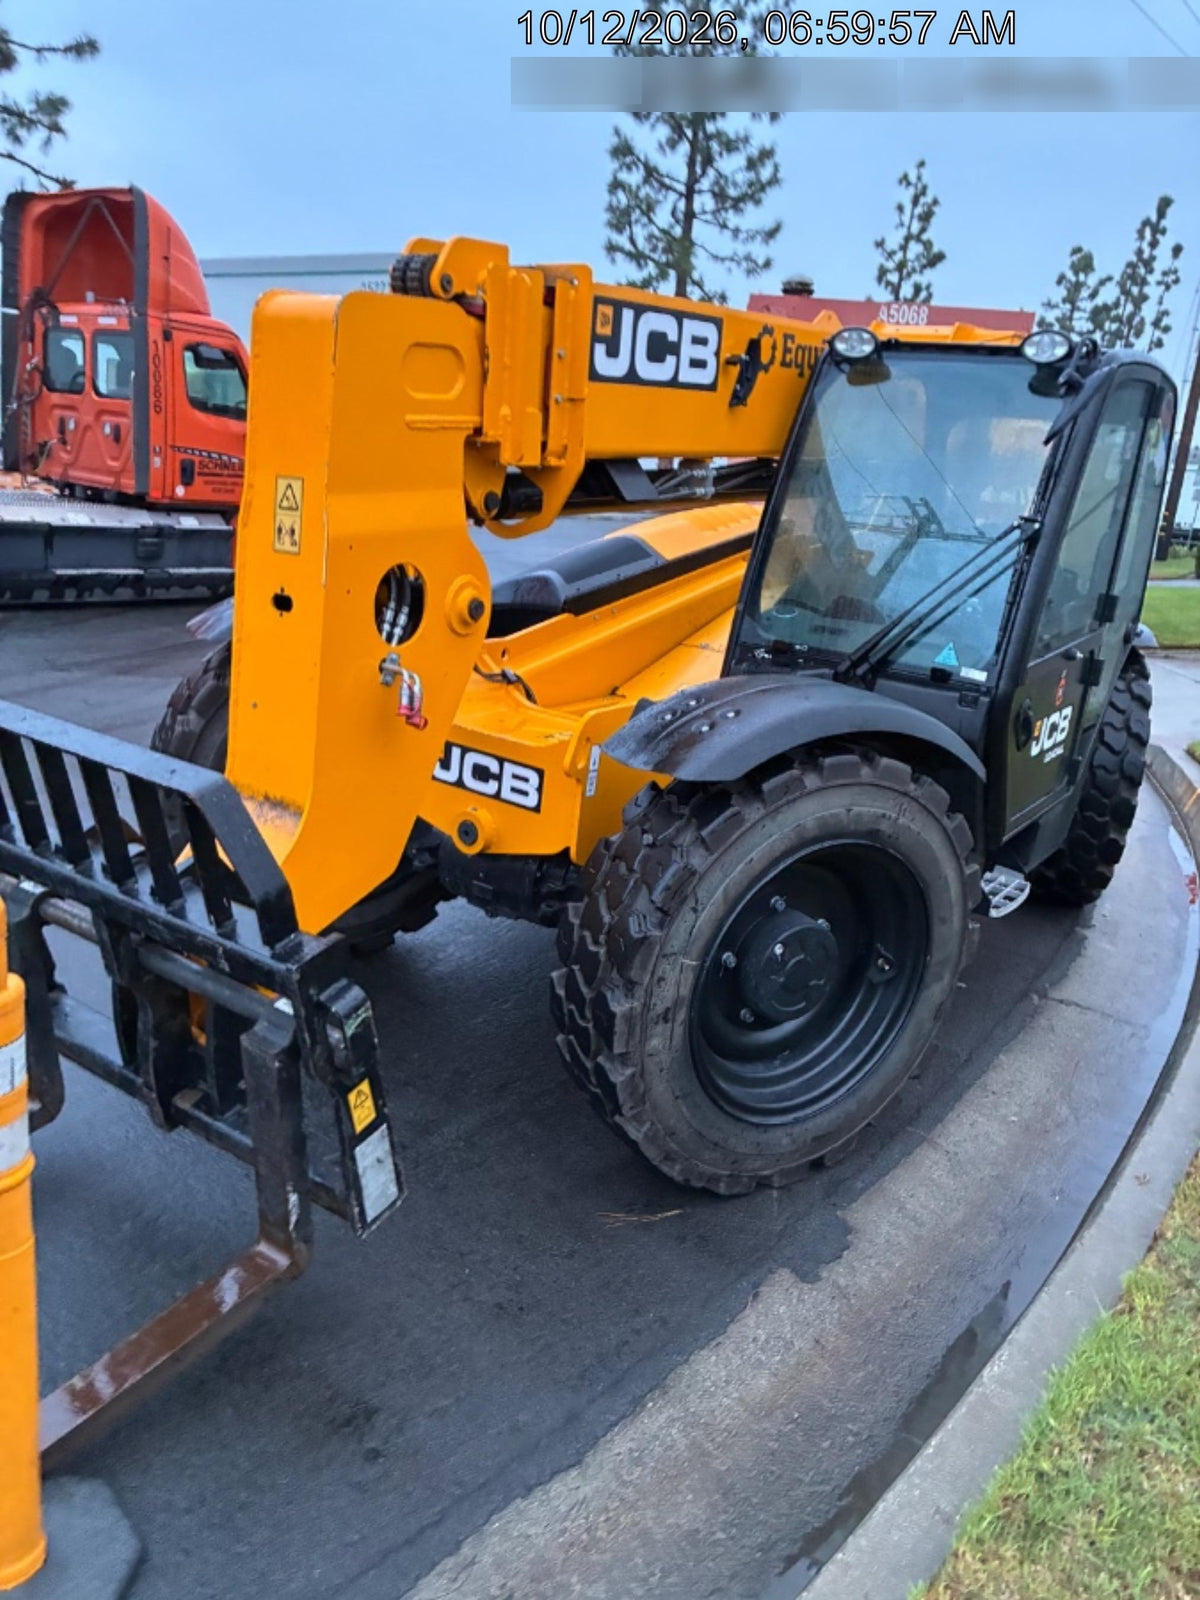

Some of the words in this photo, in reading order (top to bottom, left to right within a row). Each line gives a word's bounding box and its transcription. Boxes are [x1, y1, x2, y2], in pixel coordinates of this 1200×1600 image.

[593, 306, 719, 386] JCB
[1030, 704, 1073, 758] JCB
[432, 745, 540, 809] JCB
